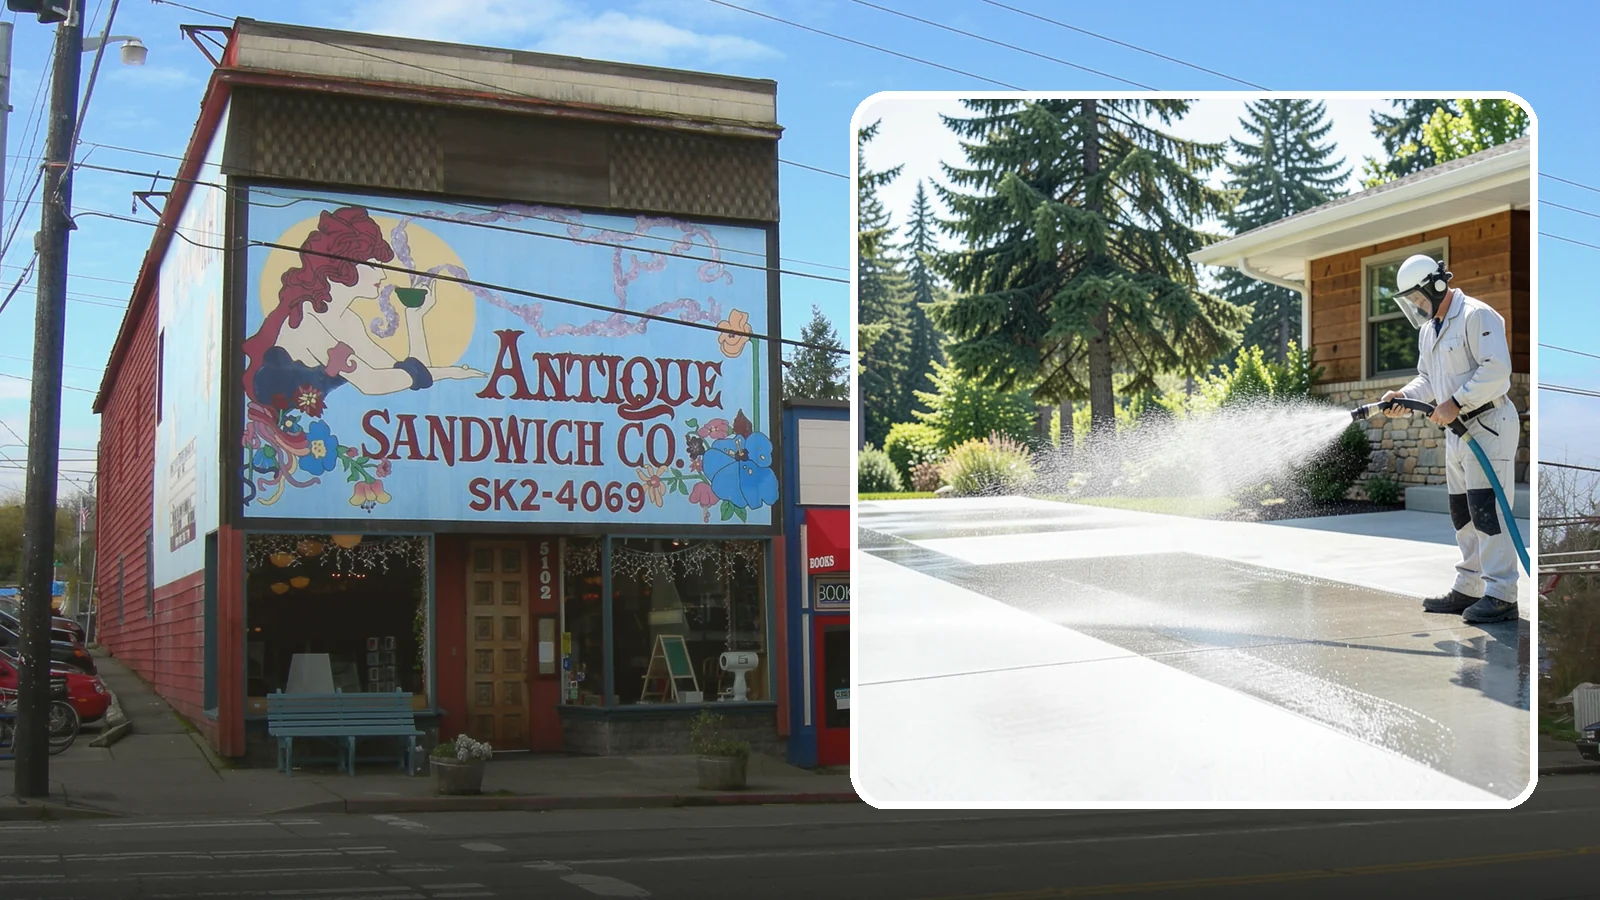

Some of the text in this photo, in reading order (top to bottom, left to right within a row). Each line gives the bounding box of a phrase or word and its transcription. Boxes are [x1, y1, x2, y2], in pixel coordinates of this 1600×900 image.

[476, 329, 724, 421] ANTIQUE
[361, 409, 684, 469] SANDWICH CO.
[468, 477, 646, 513] SK2-4069
[540, 541, 551, 599] 5102
[809, 555, 835, 569] BOOKS
